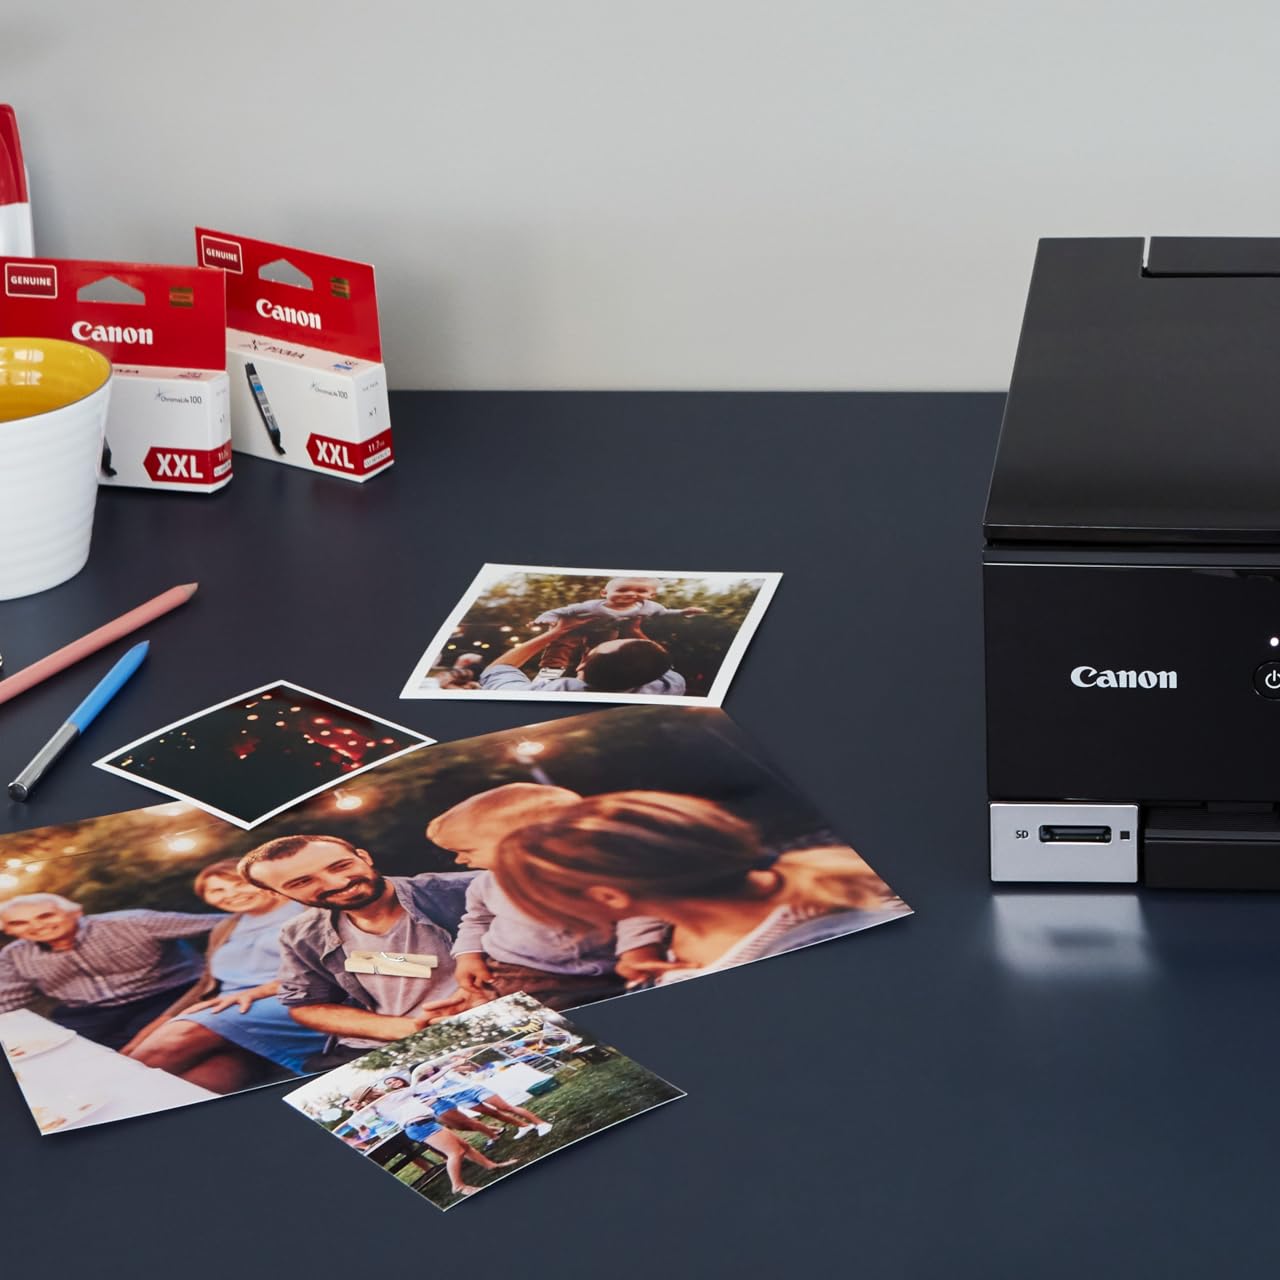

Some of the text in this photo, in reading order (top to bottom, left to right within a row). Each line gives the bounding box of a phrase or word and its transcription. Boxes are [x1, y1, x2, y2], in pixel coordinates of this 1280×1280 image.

[206, 248, 239, 262] GENUINE
[10, 275, 52, 287] GENUINE
[256, 298, 322, 331] Canon
[71, 320, 154, 346] Canon
[156, 452, 204, 479] XXL
[315, 438, 355, 470] XXL
[1070, 665, 1178, 689] Canon
[1015, 829, 1029, 839] SD
